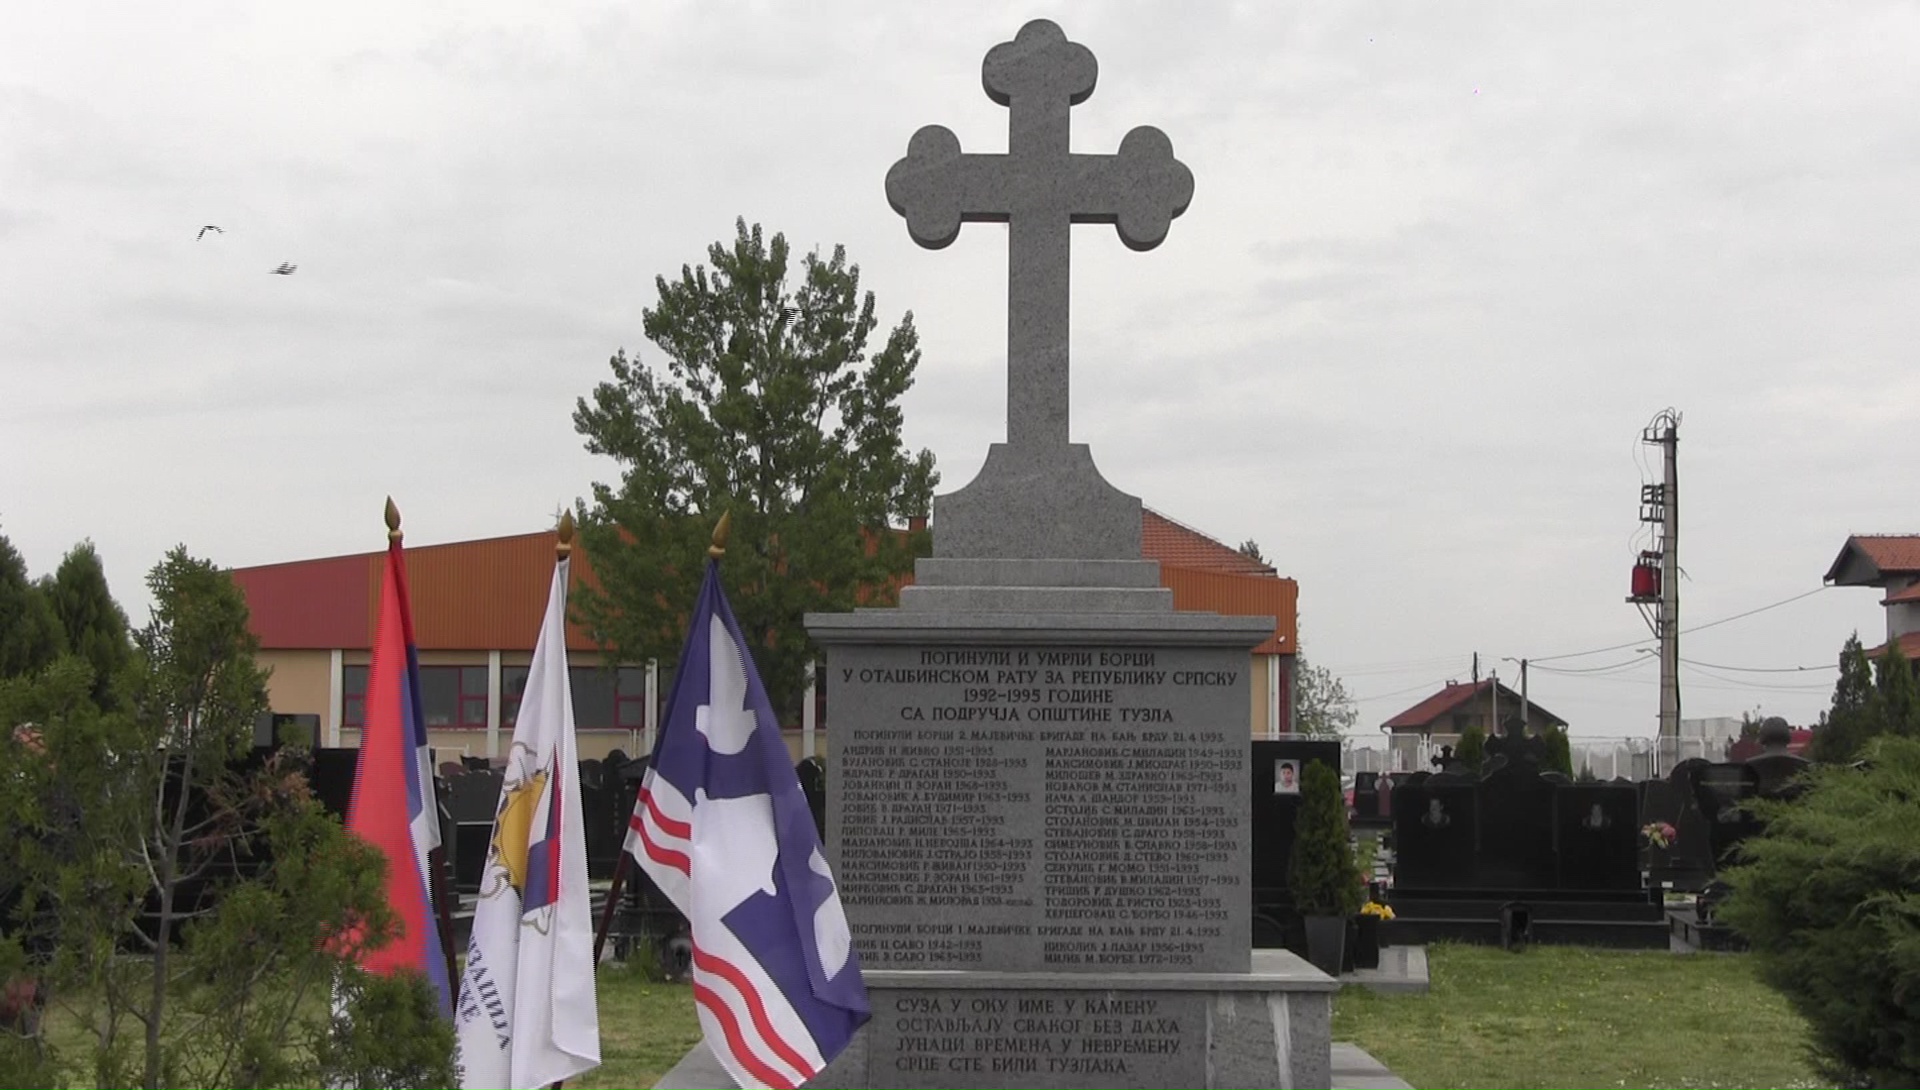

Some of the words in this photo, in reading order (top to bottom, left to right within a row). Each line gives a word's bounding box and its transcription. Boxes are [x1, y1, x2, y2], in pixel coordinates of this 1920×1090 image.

[921, 651, 1010, 665] ПОГИНУЛИ
[1018, 651, 1028, 665] И
[1037, 652, 1092, 666] УМРЛИ
[1100, 653, 1155, 667] БОРЦИ
[843, 669, 853, 683] У
[860, 669, 988, 683] ОТАЏБИНСКОМ
[998, 670, 1037, 684] РАТУ
[1045, 670, 1065, 684] ЗА
[1072, 671, 1166, 685] РЕПУБЛИКУ
[1173, 671, 1237, 685] СРПСКУ
[964, 689, 1040, 703] 1992-1995
[1048, 689, 1113, 703] ГОДИНЕ
[901, 707, 924, 720] СА
[933, 707, 1019, 721] ПОДРУЧЈА
[1028, 708, 1111, 721] ОПШТИНЕ
[1120, 708, 1173, 722] ТУЗЛА
[896, 998, 941, 1013] СУЗА
[951, 999, 961, 1012] У
[972, 999, 1007, 1013] ОКУ
[1019, 999, 1054, 1013] ИМЕ
[1065, 1000, 1075, 1014] У
[897, 1018, 1003, 1032] ОСТАВЉАЈУ
[1014, 1019, 1083, 1033] СВАКОГ
[1094, 1020, 1122, 1033] БЕЗ
[897, 1038, 964, 1052] ЈУНАЦИ
[975, 1038, 1052, 1053] ВРЕМЕНА
[1062, 1039, 1071, 1052] У
[896, 1058, 939, 1071] СРЦЕ
[949, 1058, 982, 1071] СТЕ
[992, 1058, 1036, 1072] БИЛИ
